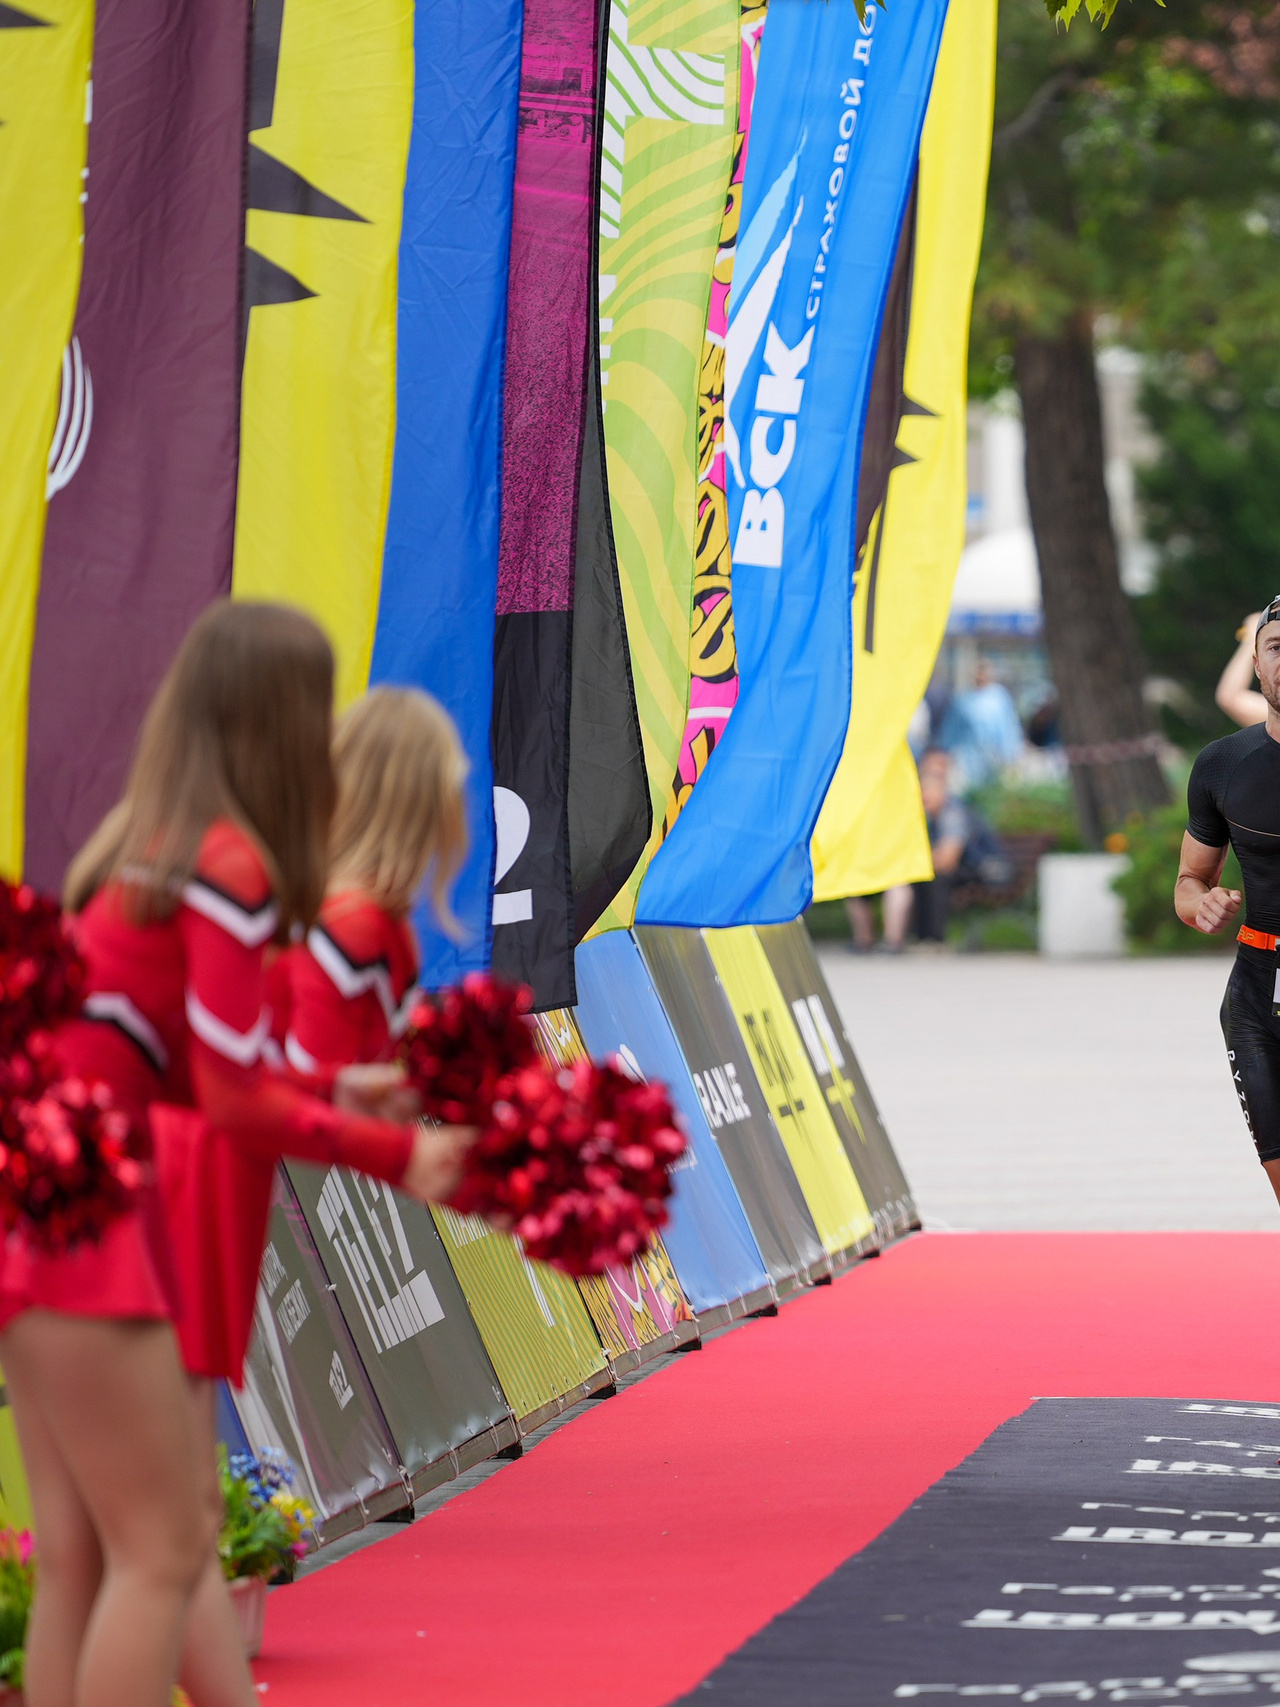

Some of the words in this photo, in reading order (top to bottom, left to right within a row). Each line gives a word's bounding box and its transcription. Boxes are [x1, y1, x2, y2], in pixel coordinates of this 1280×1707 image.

[805, 77, 865, 320] СТРАХОВОЙ
[732, 320, 816, 569] ВСК
[975, 1609, 1276, 1625] IRON
